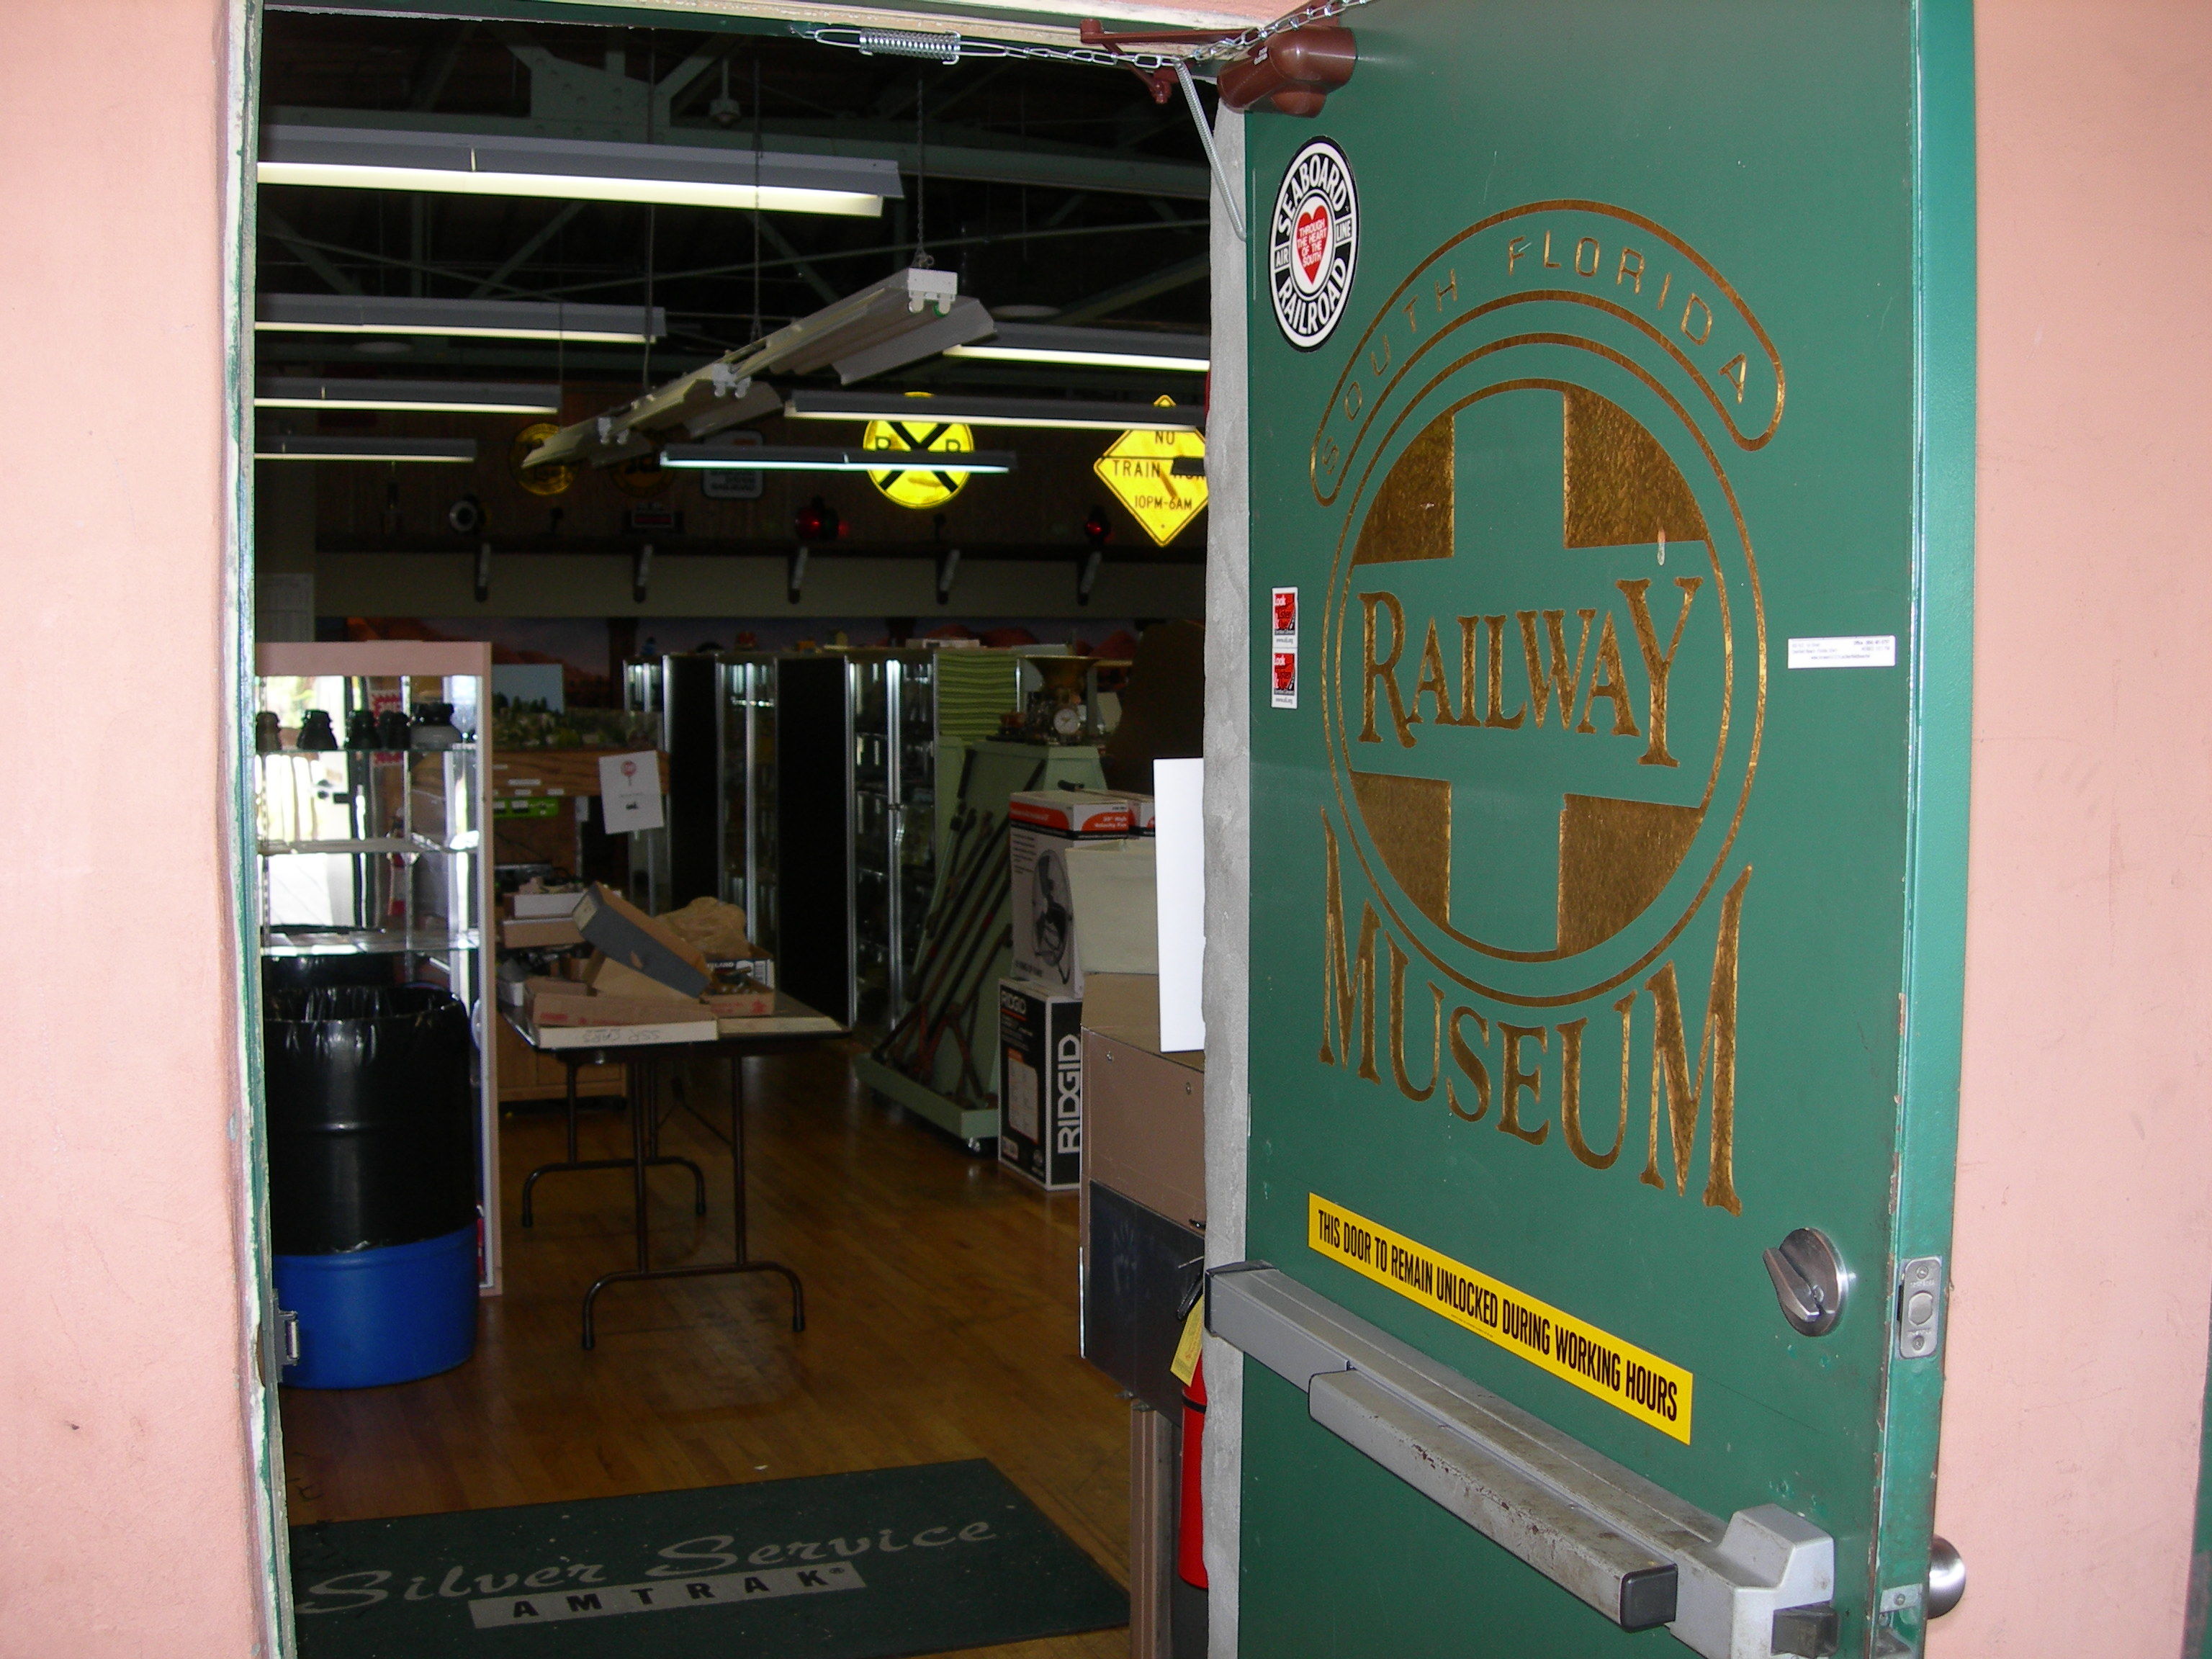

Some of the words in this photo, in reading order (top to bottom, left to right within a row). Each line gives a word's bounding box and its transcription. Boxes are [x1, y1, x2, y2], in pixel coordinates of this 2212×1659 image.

[1278, 154, 1347, 236] SEABOARD
[1274, 247, 1289, 269] AIR
[1297, 235, 1308, 248] THE
[1308, 228, 1327, 243] HEART
[1299, 218, 1326, 237] THROUGH
[1302, 245, 1310, 257] OF
[1311, 239, 1323, 252] THE
[1303, 250, 1322, 267] SOUTH
[1336, 218, 1352, 243] LINE
[1278, 257, 1346, 336] RAILROAD
[1321, 269, 1458, 475] SOUTH
[1508, 230, 1748, 404] FLORIDA
[1112, 459, 1161, 478] TRAIN
[1357, 577, 1703, 768] RAILWAY
[1318, 805, 1753, 1217] MUSEUM
[1058, 1033, 1081, 1154] RIDGID
[1318, 1210, 1341, 1249] THIS
[1344, 1221, 1372, 1265] DOOR
[1375, 1236, 1388, 1273] TO
[1391, 1245, 1434, 1297] REMAIN
[1436, 1267, 1498, 1329] UNLOCKED
[1502, 1298, 1550, 1357] DURING
[1555, 1324, 1622, 1392] WORKING
[1626, 1361, 1678, 1422] HOURS
[295, 1565, 606, 1614] Silver
[645, 1521, 997, 1577] Service
[513, 1568, 828, 1618] AMTRAK
